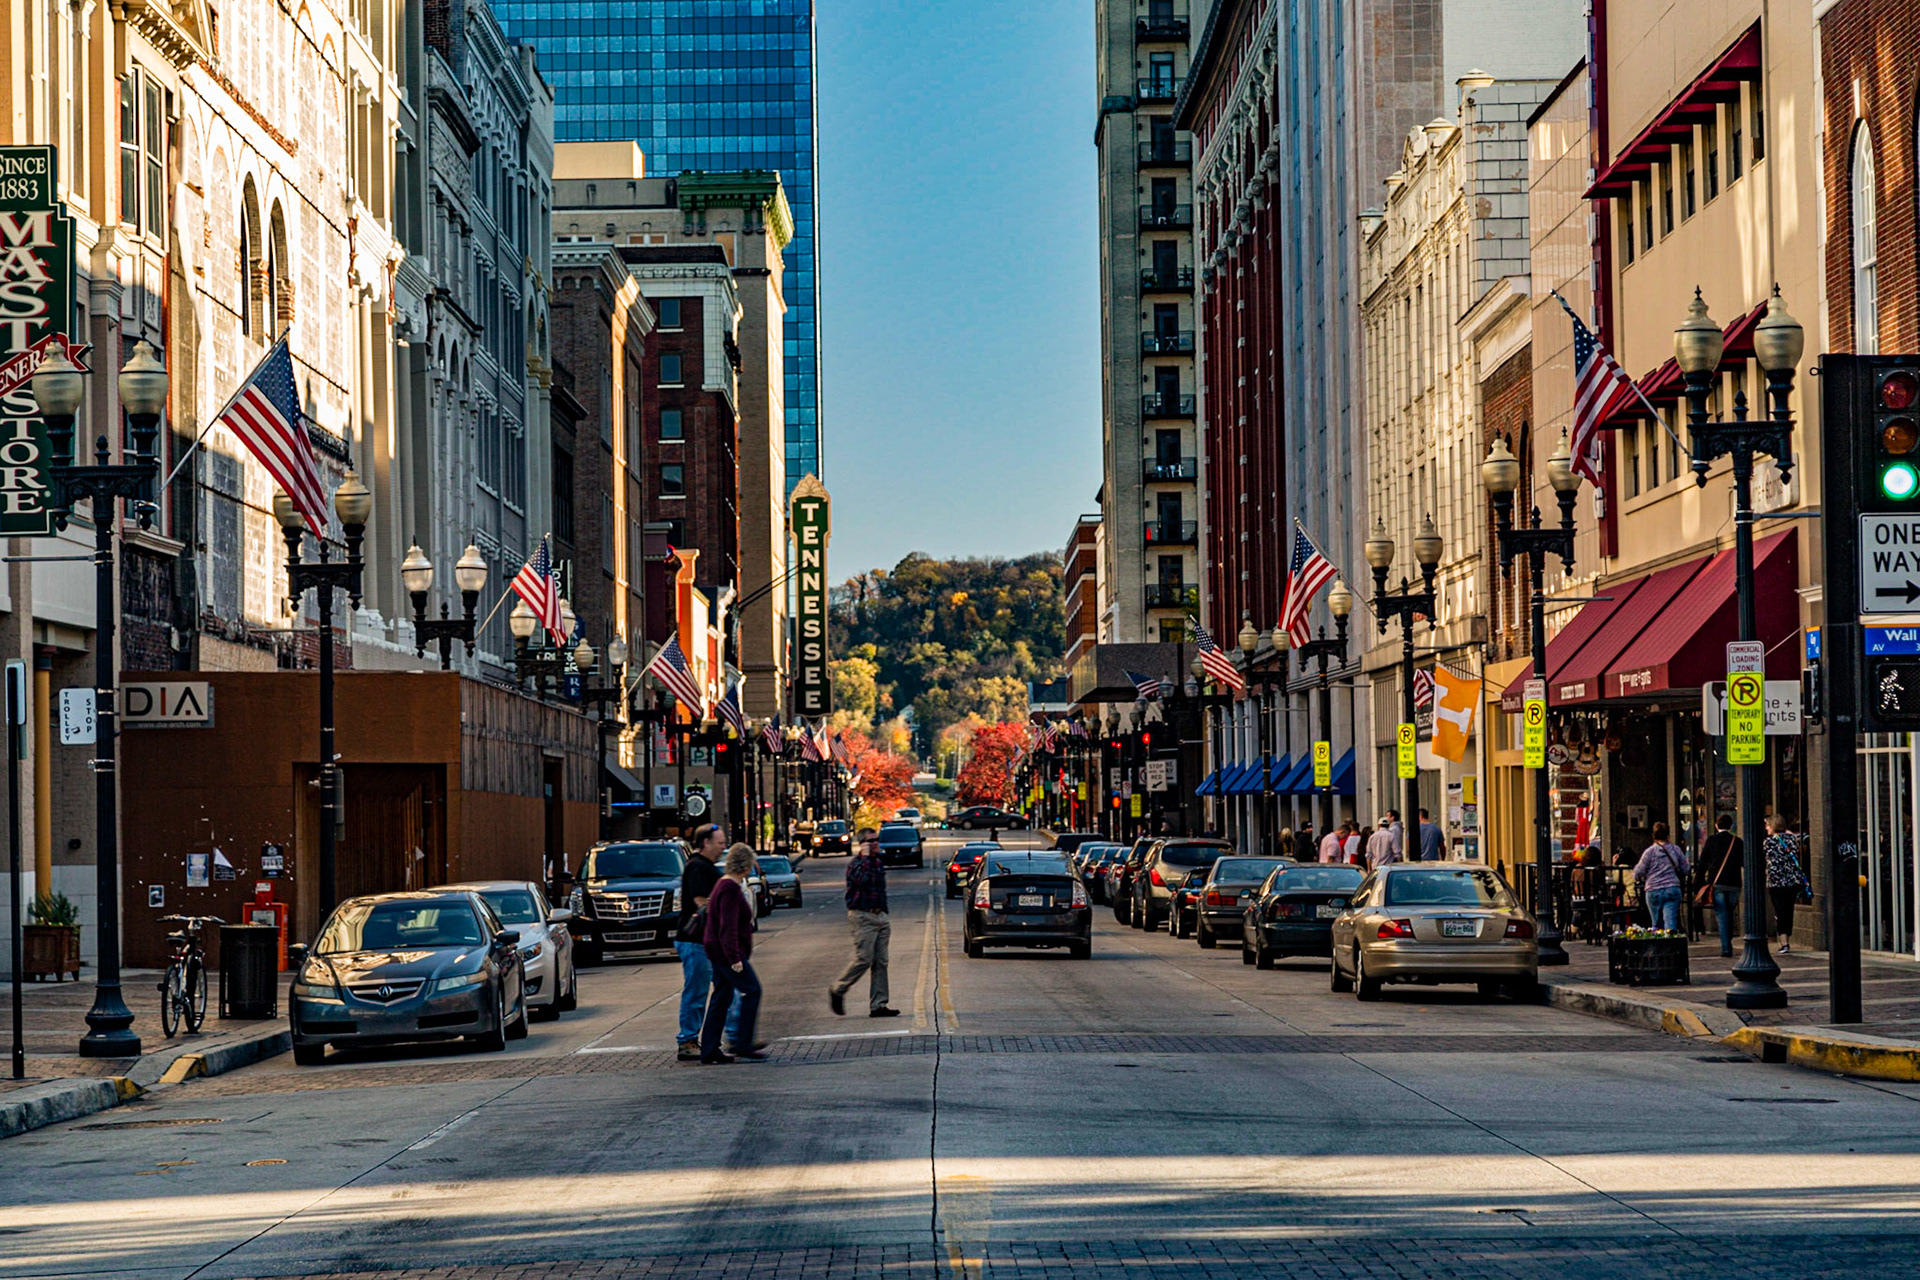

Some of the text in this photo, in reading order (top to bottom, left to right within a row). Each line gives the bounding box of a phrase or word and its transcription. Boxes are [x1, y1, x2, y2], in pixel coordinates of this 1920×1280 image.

[0, 178, 39, 200] 1883
[0, 210, 57, 354] MAST
[0, 389, 47, 514] STORE
[1875, 523, 1920, 544] ONE
[1873, 551, 1920, 573] WAY
[801, 503, 821, 709] TENNESSEE
[1885, 629, 1917, 641] Wall
[1872, 643, 1885, 651] AV
[1731, 655, 1760, 663] LOADING
[125, 687, 204, 716] DIA
[63, 691, 93, 741] TROLLEY STOP
[1731, 709, 1761, 719] TEMPORARY
[1739, 722, 1753, 731] NO
[1731, 735, 1761, 744] PARKING
